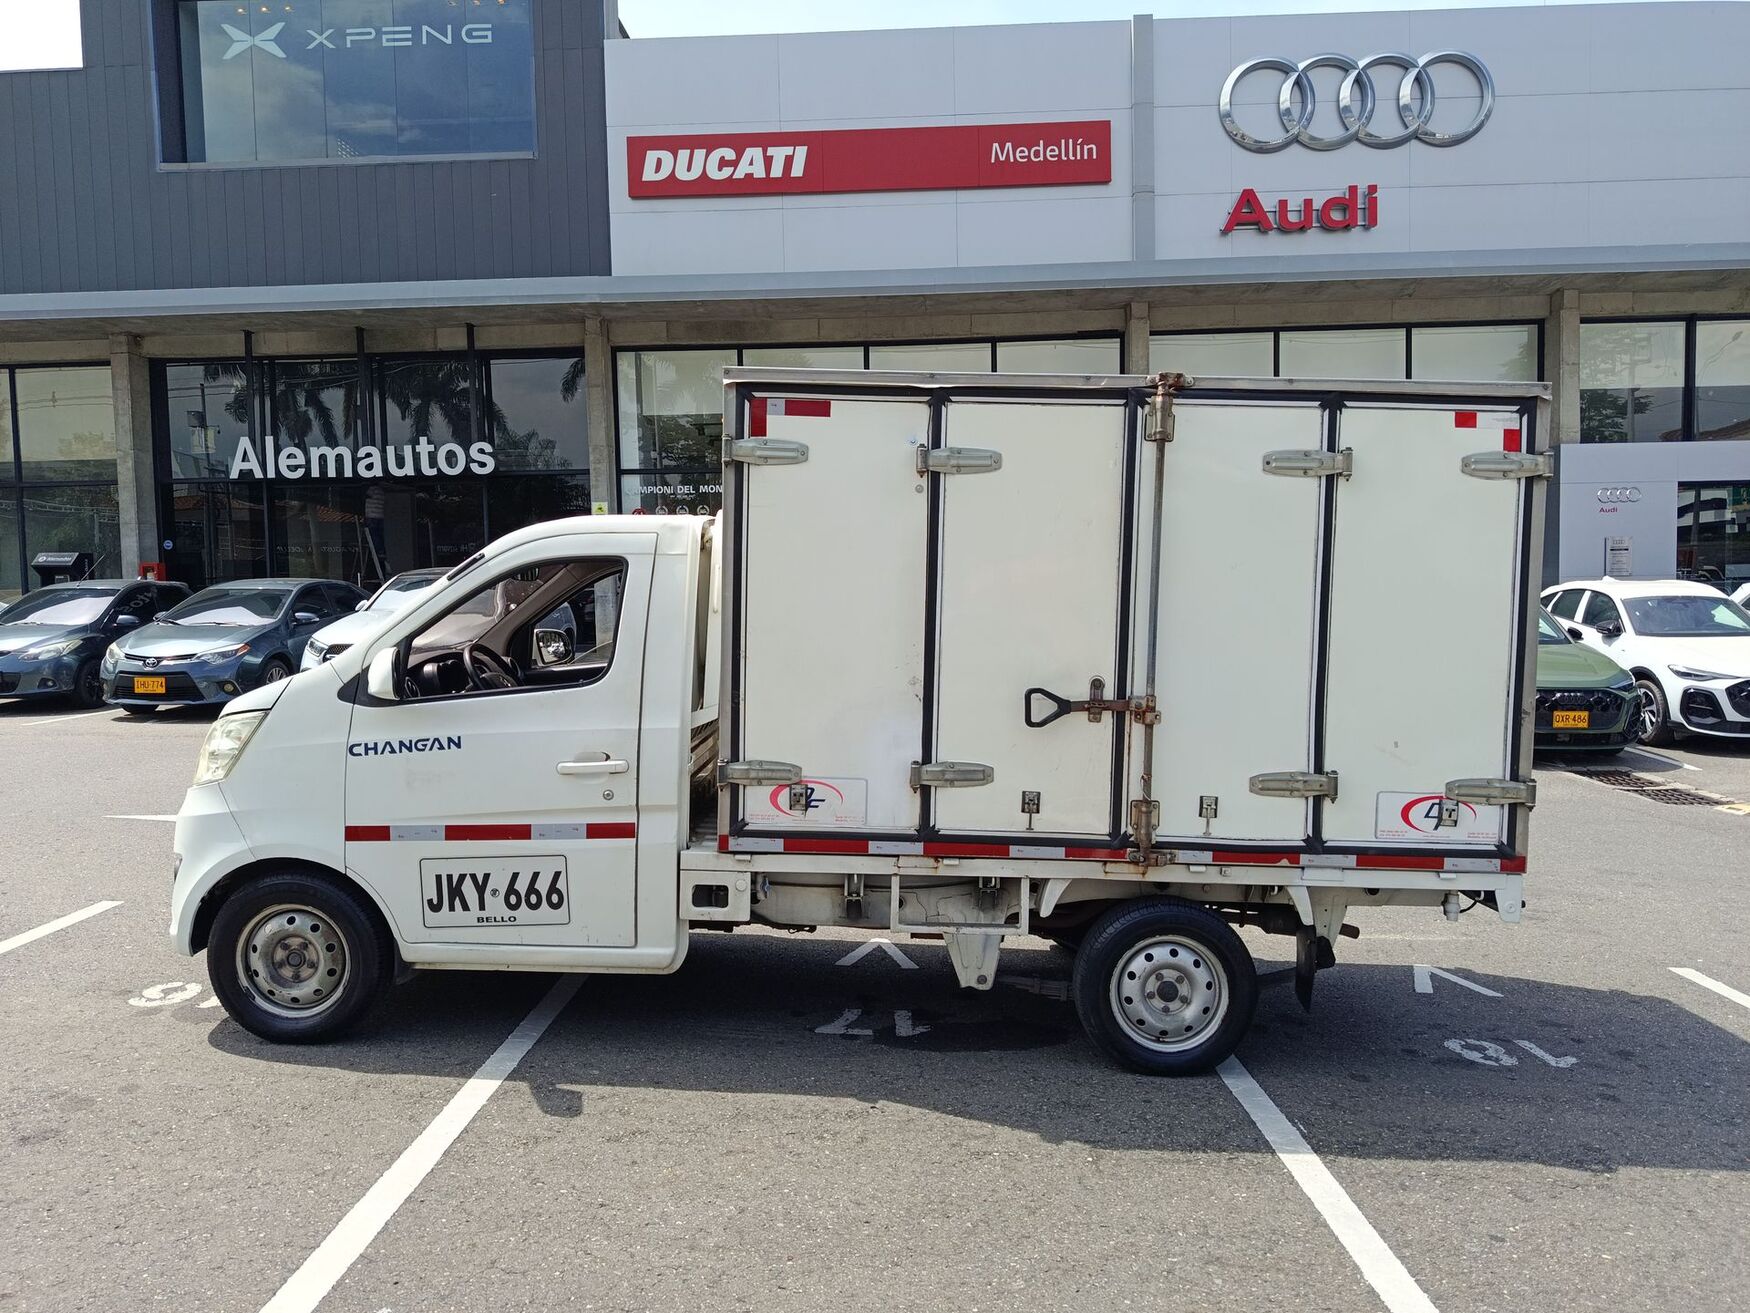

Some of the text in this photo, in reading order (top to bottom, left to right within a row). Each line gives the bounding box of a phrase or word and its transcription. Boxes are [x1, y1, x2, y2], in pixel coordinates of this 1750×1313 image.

[305, 23, 493, 50] XPENG
[641, 145, 808, 183] DUCATI
[990, 137, 1097, 165] Medellín
[1221, 184, 1378, 234] Audi
[229, 435, 496, 480] Alemautos
[628, 485, 674, 495] MPIONI
[677, 485, 695, 494] DEL
[348, 735, 462, 757] CHANGAN
[426, 870, 565, 914] JKY 666
[476, 916, 517, 924] BELLO
